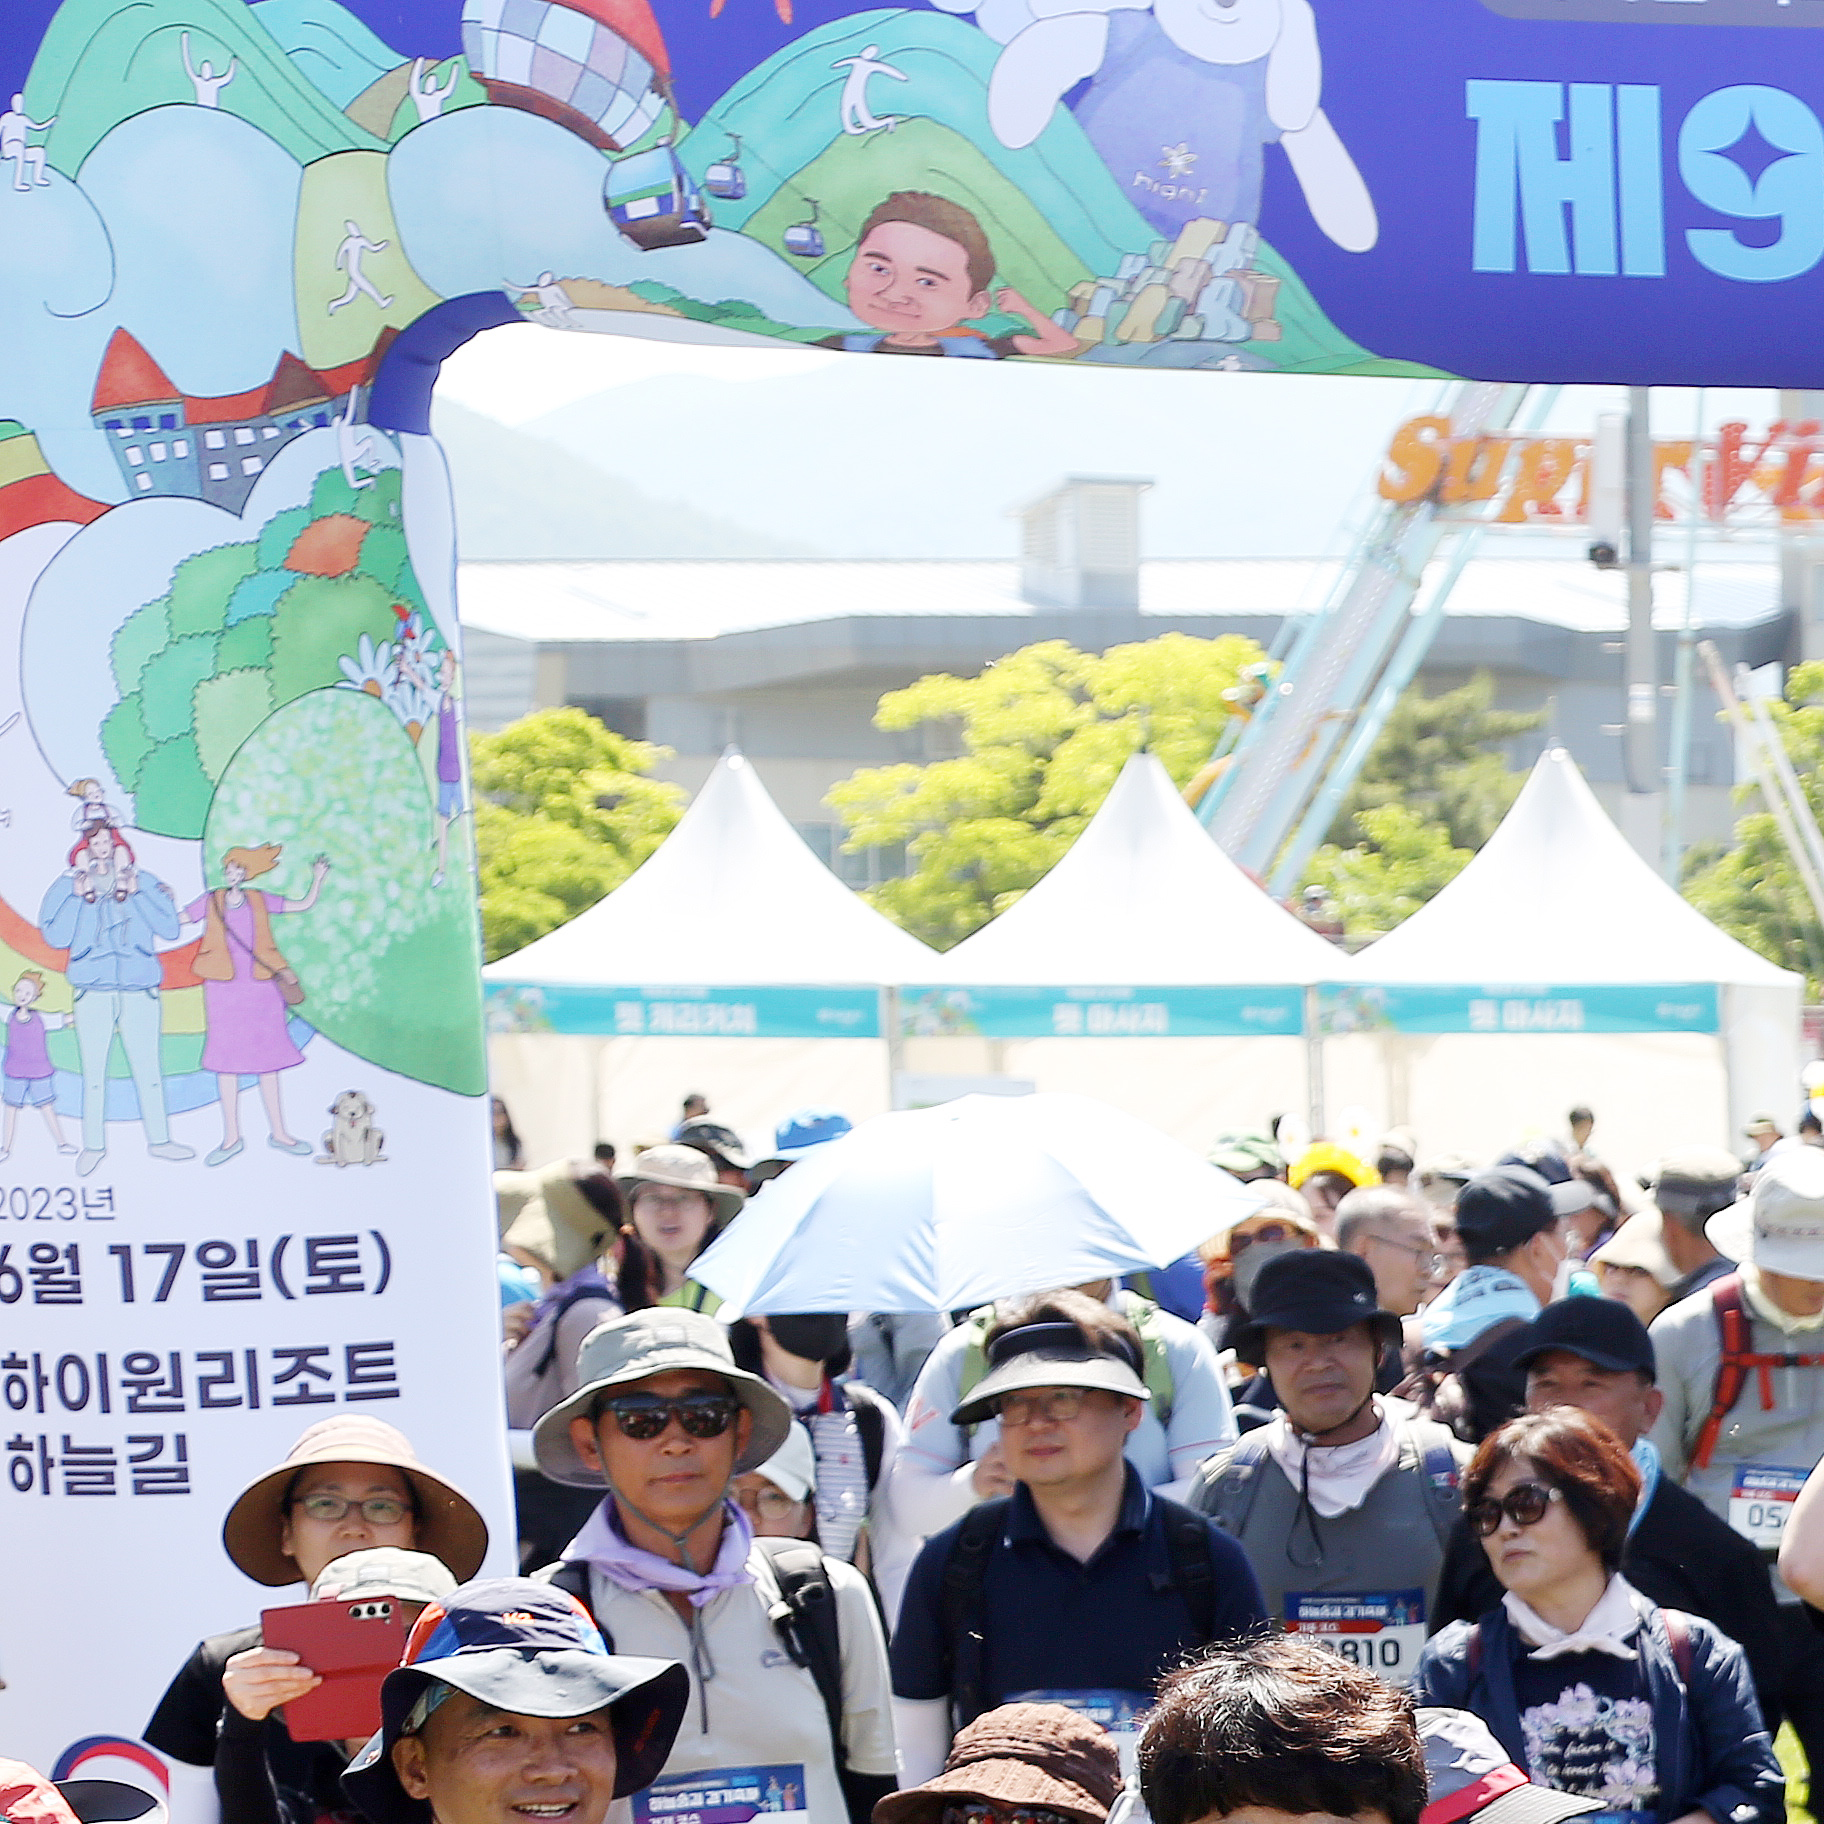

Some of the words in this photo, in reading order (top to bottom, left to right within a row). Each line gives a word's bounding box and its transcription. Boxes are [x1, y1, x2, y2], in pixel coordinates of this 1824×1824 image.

[108, 1229, 392, 1303] 17일(토)
[1, 1340, 400, 1414] 하이원리조트
[6, 1433, 190, 1496] 하늘길
[1321, 1638, 1400, 1667] 810
